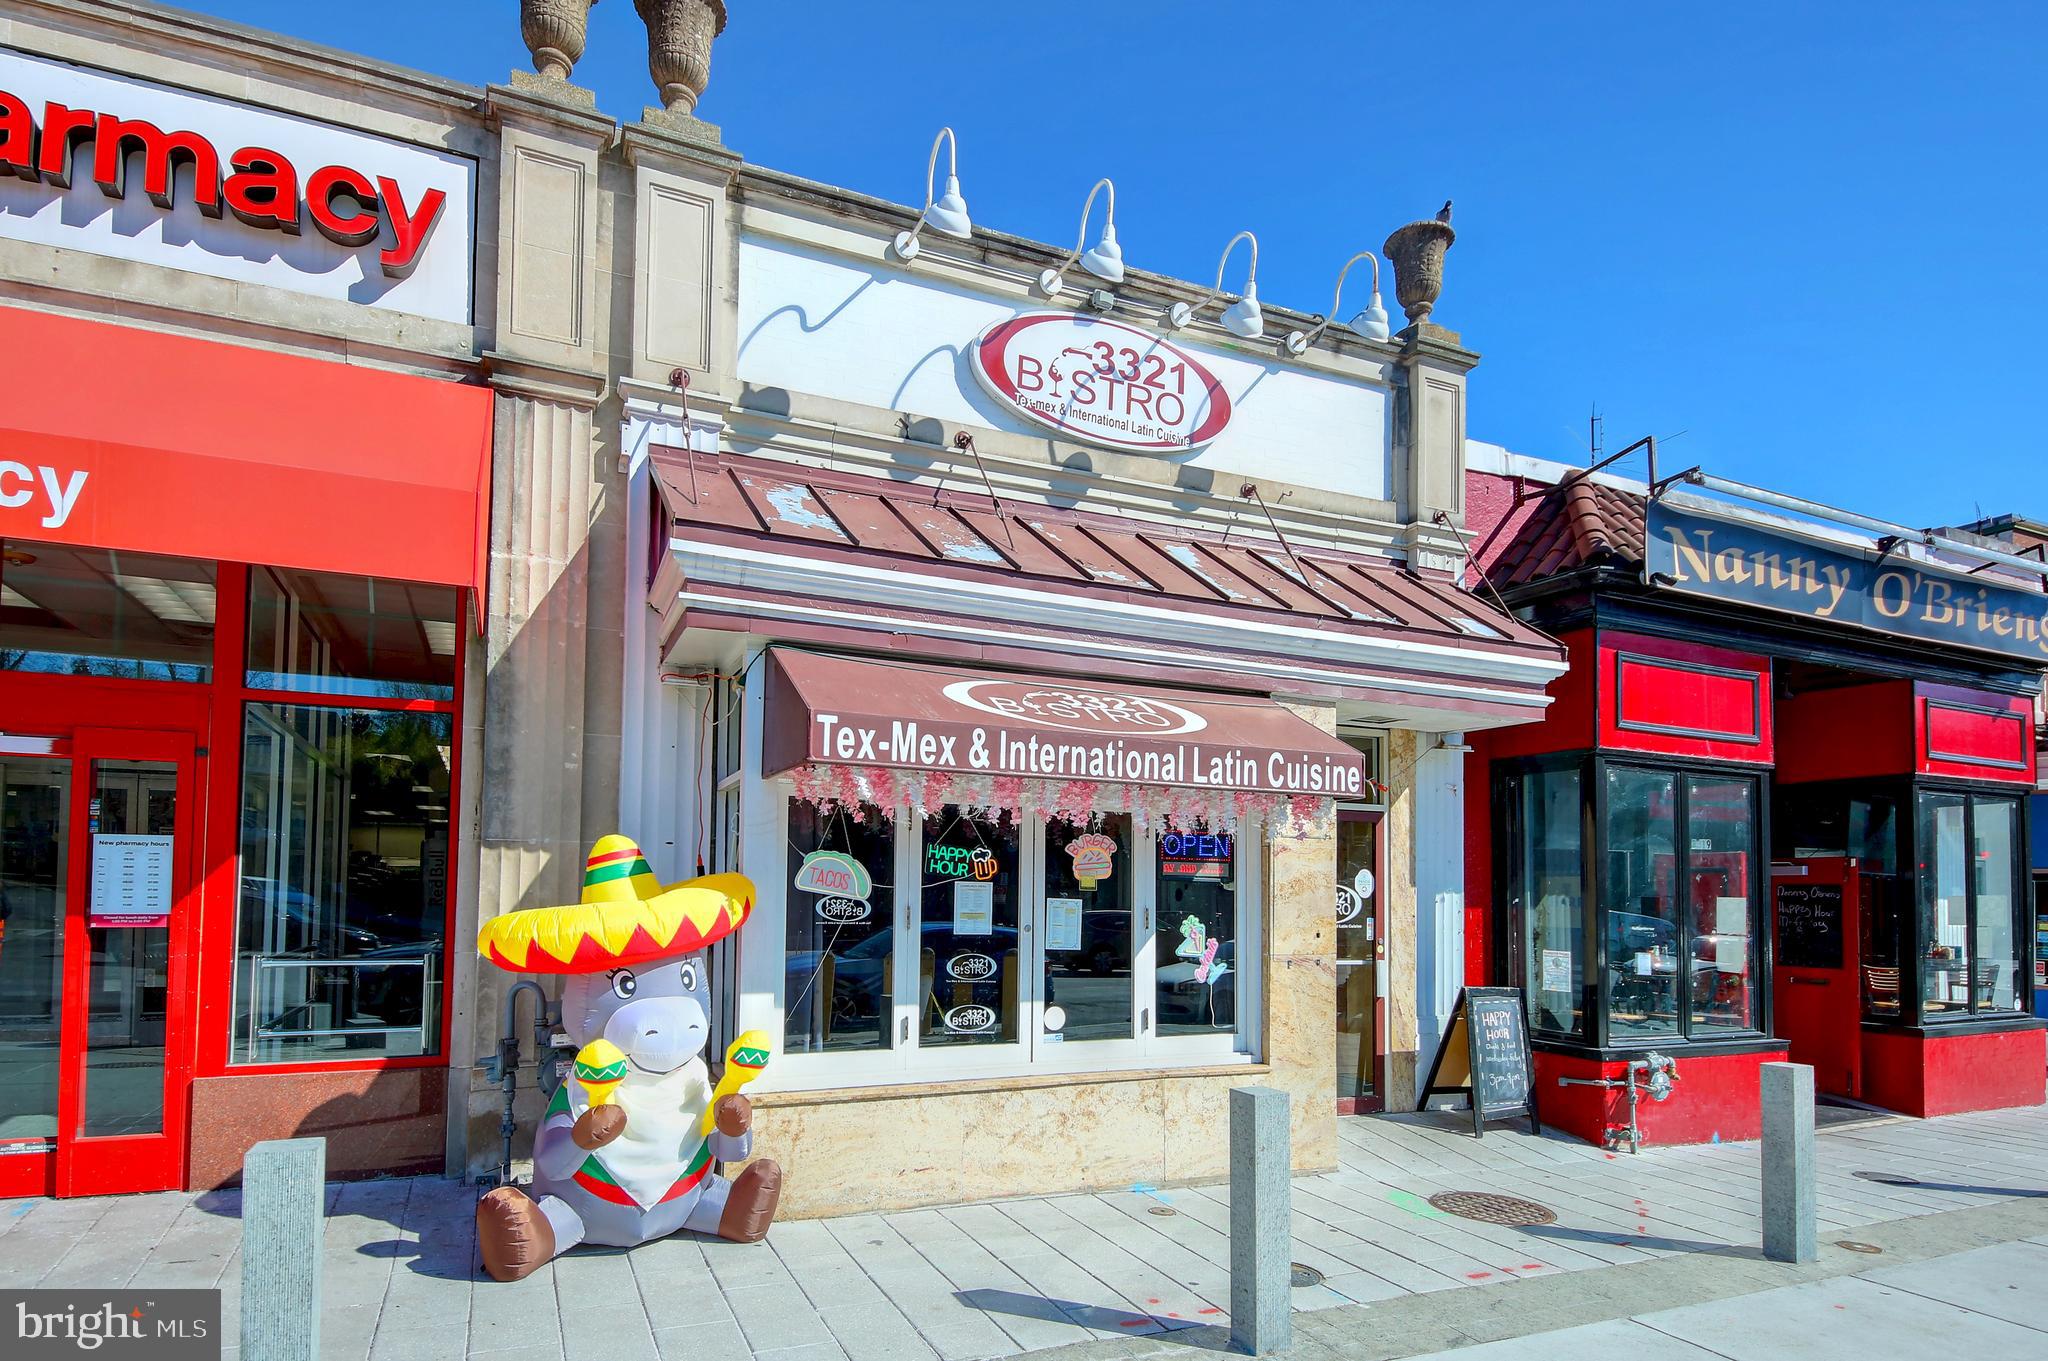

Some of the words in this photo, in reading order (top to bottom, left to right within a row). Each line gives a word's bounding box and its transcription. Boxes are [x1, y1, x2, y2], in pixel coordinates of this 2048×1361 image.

[1092, 340, 1185, 395] 3321
[1014, 391, 1056, 414] Tex-mex
[1059, 403, 1067, 416] &
[1069, 405, 1129, 431] International
[1131, 420, 1154, 438] Latin
[1156, 427, 1191, 447] Cuisine
[1663, 525, 1851, 617] Nanny
[1050, 692, 1158, 715] 3321
[817, 714, 957, 767] Tex-Mex
[968, 727, 991, 769] &
[1000, 730, 1184, 782] International
[1193, 746, 1258, 786] Latin
[1268, 751, 1360, 793] Cuisine
[928, 844, 974, 864] HAPPY
[1066, 834, 1117, 857] BURGER
[1164, 834, 1229, 857] OPEN
[429, 850, 445, 877] Bull
[930, 859, 969, 877] HOUR
[810, 866, 851, 890] TACOS
[969, 958, 989, 968] 3321
[967, 1009, 988, 1018] 3321
[1481, 1010, 1511, 1027] HAPPY
[1486, 1028, 1510, 1041] HOUR
